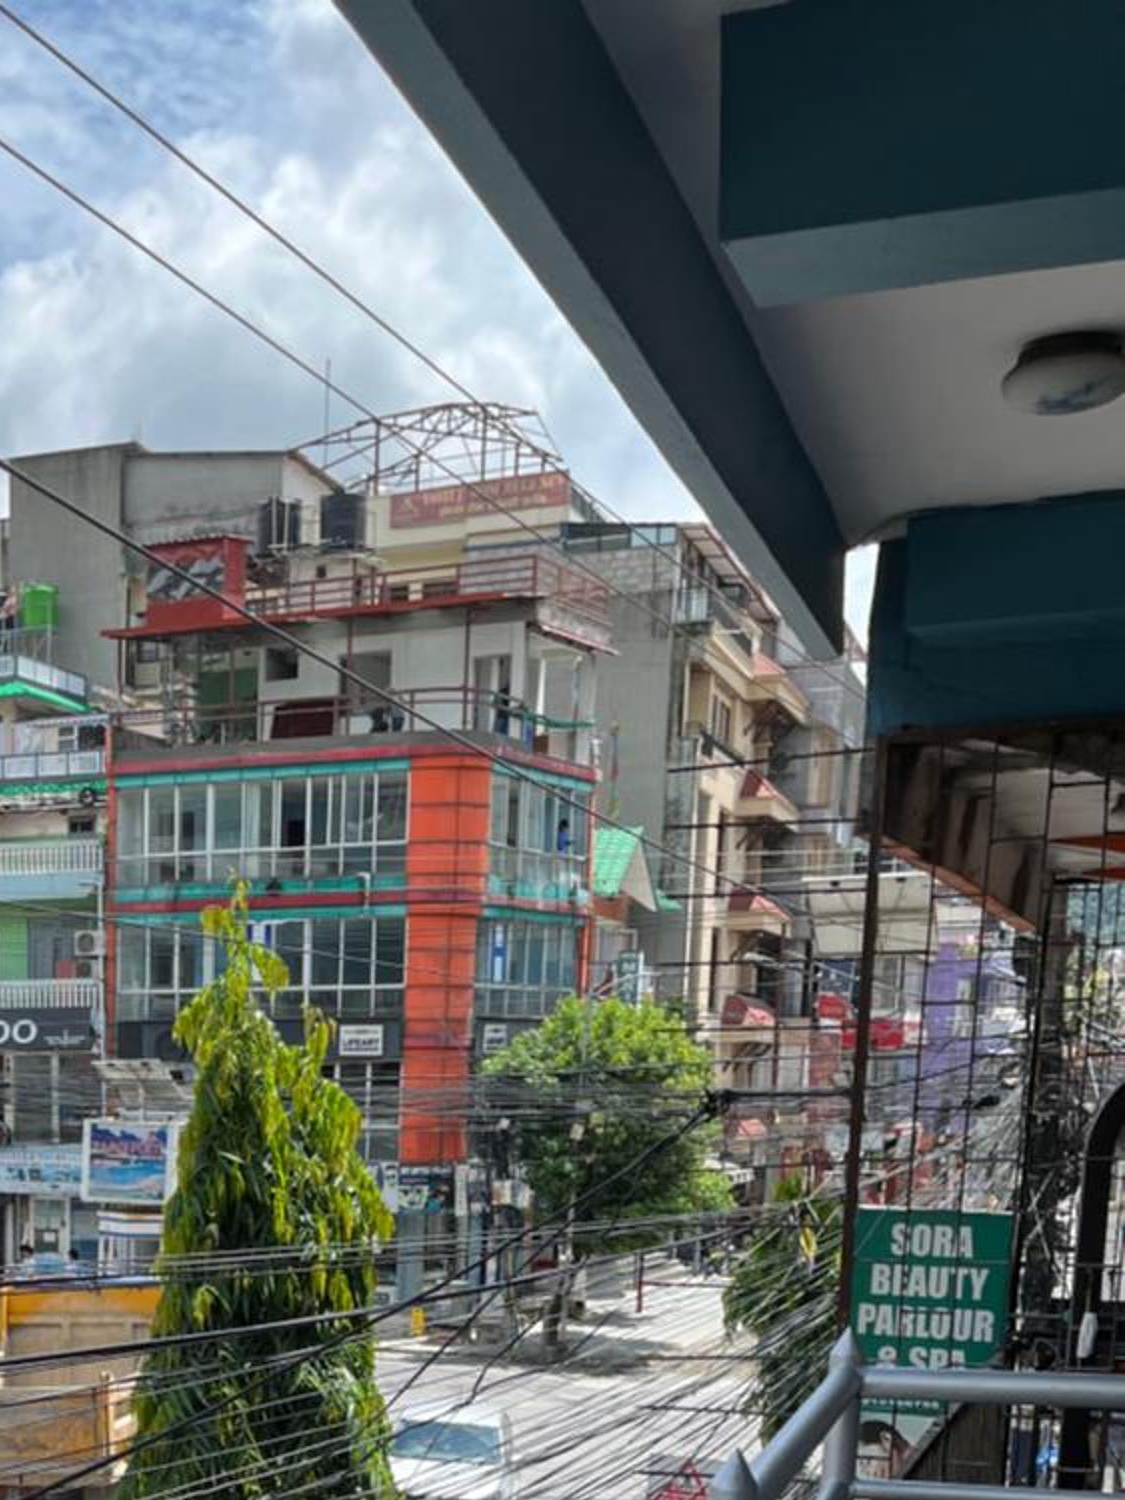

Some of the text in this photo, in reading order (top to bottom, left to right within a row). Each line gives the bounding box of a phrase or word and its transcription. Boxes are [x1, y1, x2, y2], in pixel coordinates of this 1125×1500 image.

[890, 1222, 974, 1259] SORA
[870, 1263, 990, 1301] BEAUTY
[856, 1302, 995, 1343] PARLOUR
[908, 1346, 967, 1371] SPA
